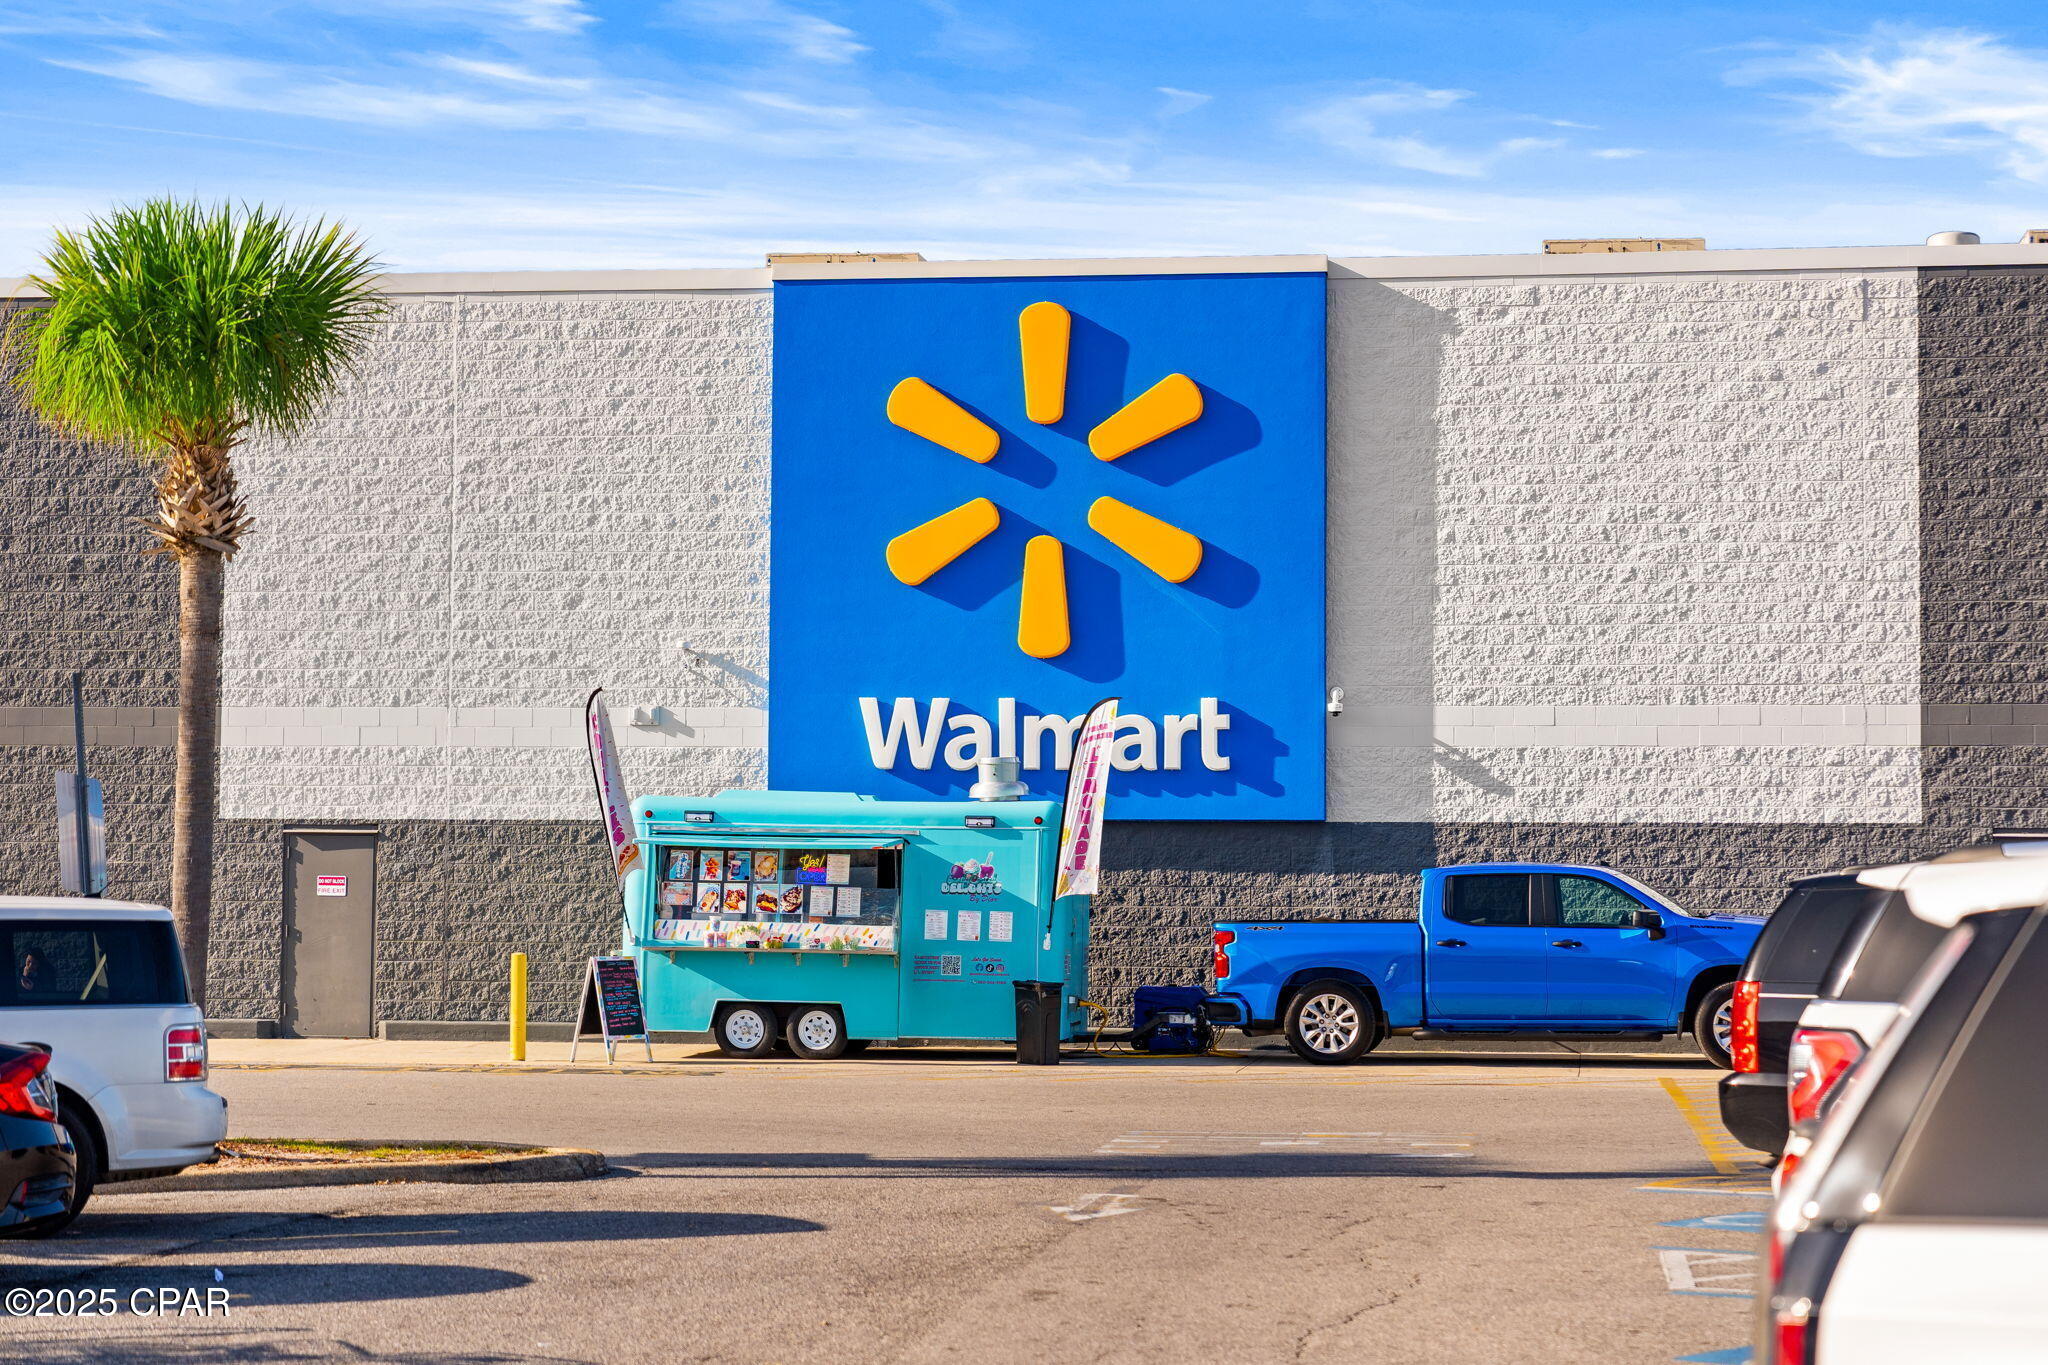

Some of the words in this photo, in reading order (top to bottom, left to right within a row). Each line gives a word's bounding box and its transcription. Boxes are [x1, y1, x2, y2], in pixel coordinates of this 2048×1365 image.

[858, 697, 1231, 772] Walmart
[1074, 746, 1098, 870] LEMONADE
[800, 854, 826, 871] Yes!
